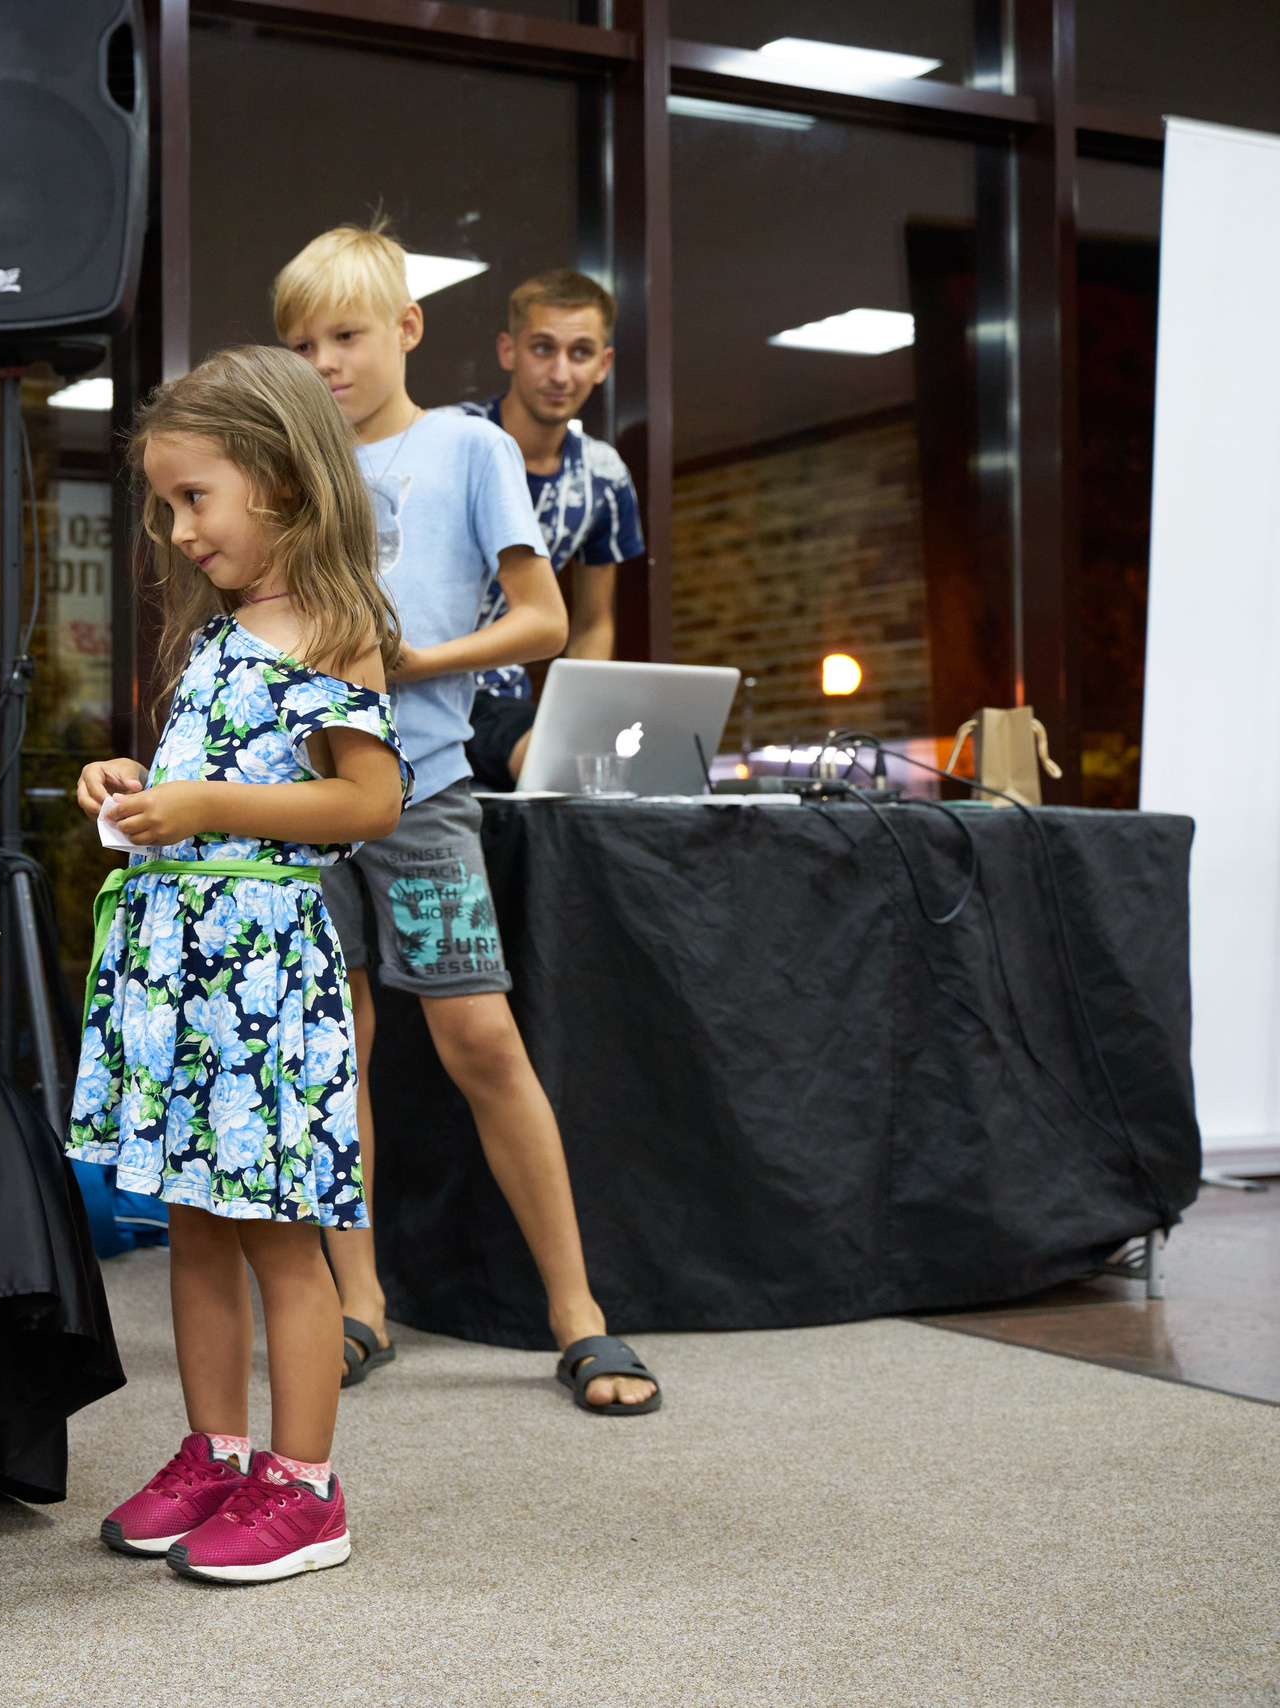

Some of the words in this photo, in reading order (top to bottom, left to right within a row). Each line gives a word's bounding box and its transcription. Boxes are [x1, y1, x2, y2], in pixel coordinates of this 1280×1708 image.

[389, 847, 454, 865] SUNSET
[412, 904, 465, 920] SHORE
[435, 937, 498, 956] SURF
